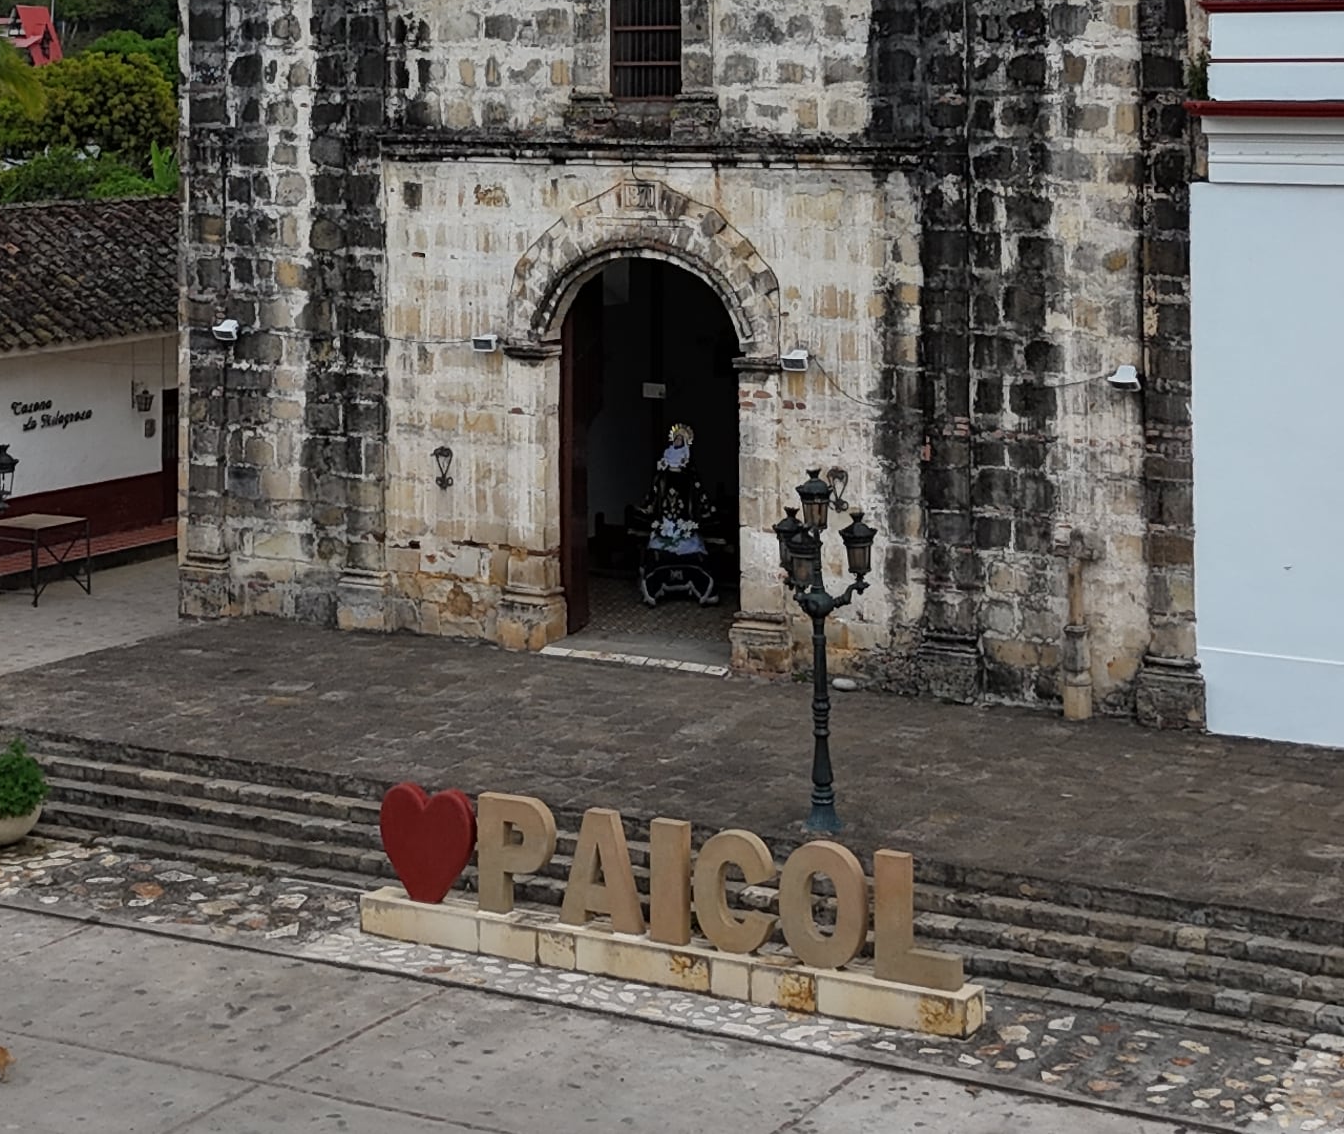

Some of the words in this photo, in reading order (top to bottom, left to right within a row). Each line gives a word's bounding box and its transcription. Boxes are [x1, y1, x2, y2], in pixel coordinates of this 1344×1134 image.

[10, 399, 53, 416] Casona
[22, 416, 37, 432] La
[476, 791, 964, 992] PAICOL
